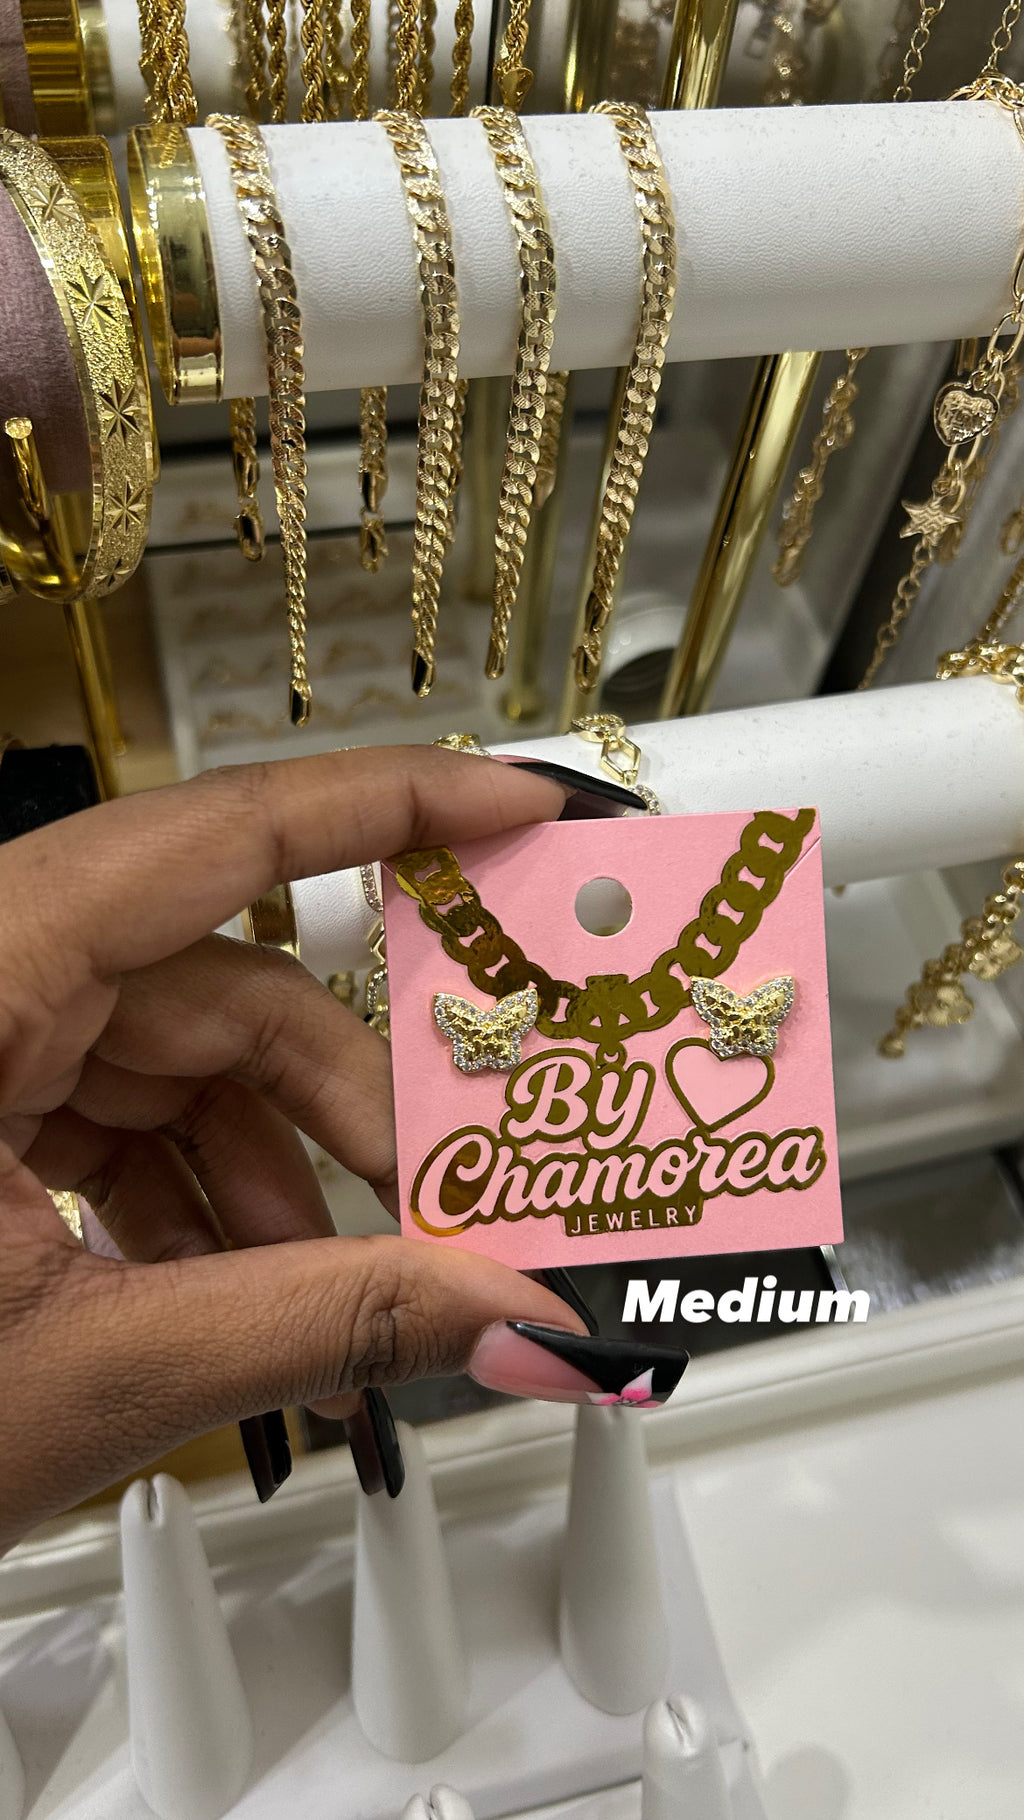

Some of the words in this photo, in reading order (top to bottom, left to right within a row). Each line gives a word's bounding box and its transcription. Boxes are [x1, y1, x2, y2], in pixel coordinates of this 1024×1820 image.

[507, 1055, 649, 1150] By
[417, 1132, 826, 1229] Chamorea
[570, 1204, 698, 1235] JEWELRY
